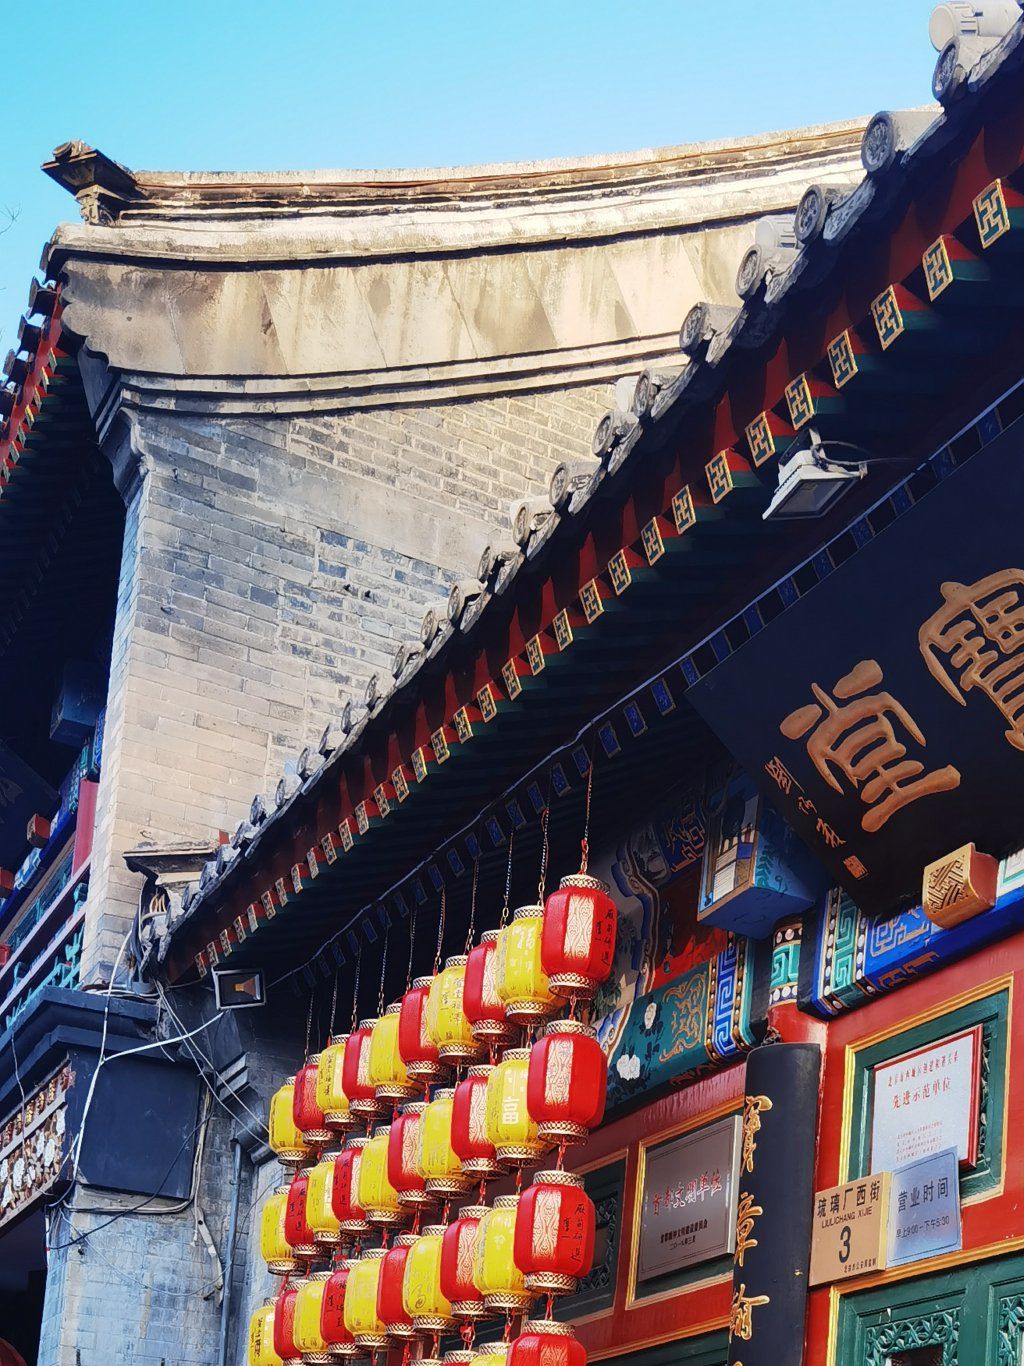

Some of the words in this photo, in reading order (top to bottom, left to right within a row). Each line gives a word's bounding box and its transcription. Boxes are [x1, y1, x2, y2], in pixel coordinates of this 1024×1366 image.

[817, 1180, 880, 1218] 琉璃厂西街
[898, 1177, 949, 1213] 营业时间
[821, 1211, 856, 1229] LIULICHANG
[858, 1206, 873, 1219] XIJIE
[839, 1225, 851, 1263] 3
